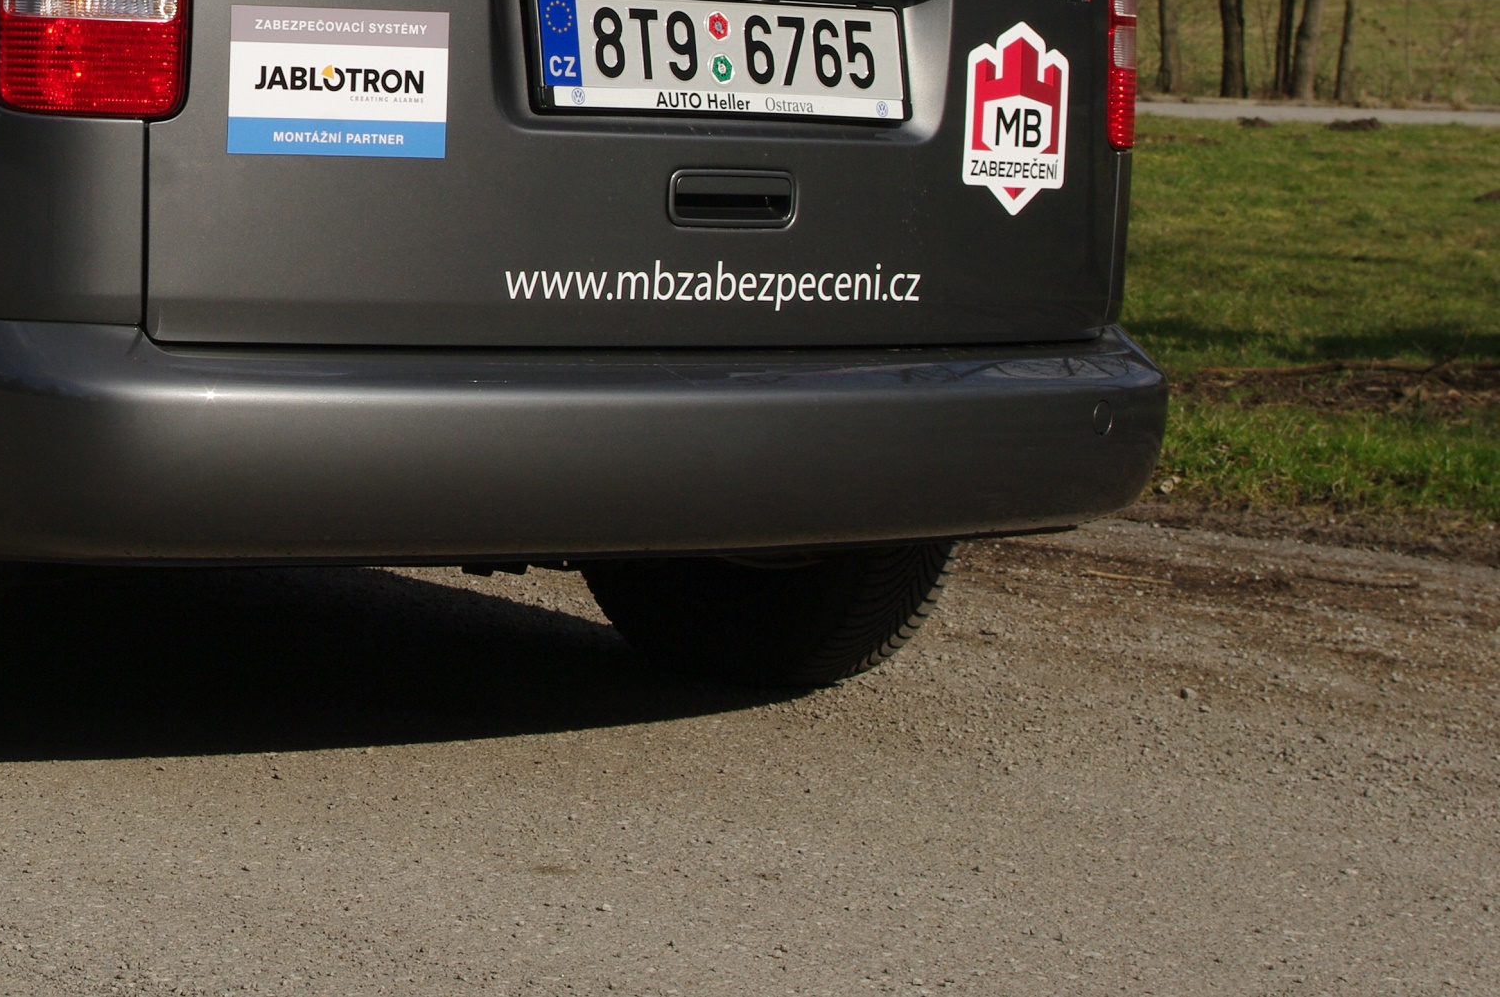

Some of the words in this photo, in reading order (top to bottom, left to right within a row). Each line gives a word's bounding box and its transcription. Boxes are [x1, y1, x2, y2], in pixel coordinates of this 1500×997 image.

[254, 18, 365, 33] ZABEZPEČOVACÍ
[368, 22, 428, 35] SYSTÉMY
[592, 6, 699, 82] 8T9
[743, 14, 876, 89] 6765
[549, 55, 577, 78] CZ
[254, 64, 425, 94] JABLOTRON
[349, 95, 389, 103] CREATING
[656, 91, 702, 109] AUTO
[707, 93, 751, 111] Heller
[764, 97, 814, 113] Ostrava
[273, 131, 342, 144] MONTÁŽNÍ
[346, 133, 405, 145] PARTNER
[994, 107, 1042, 148] MB
[970, 157, 1059, 180] ZABEZPEČENÍ
[504, 259, 921, 312] www.mbzabezpeceni.cz
